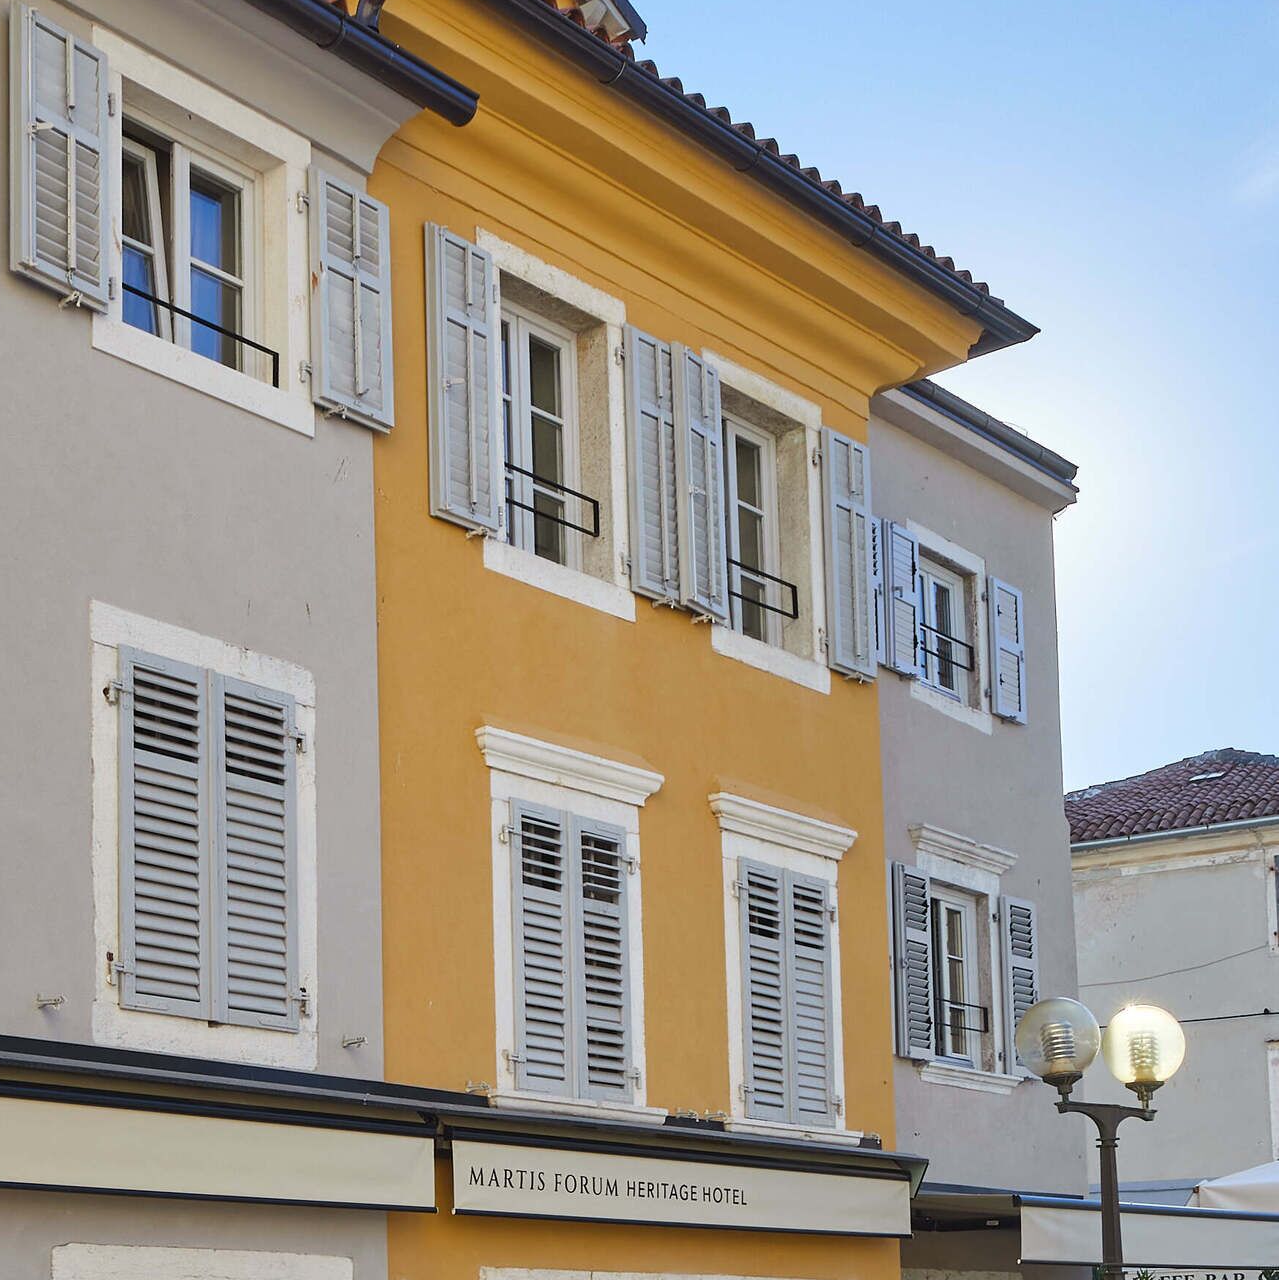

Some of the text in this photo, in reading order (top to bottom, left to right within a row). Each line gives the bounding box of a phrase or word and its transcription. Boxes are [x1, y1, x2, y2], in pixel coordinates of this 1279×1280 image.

[469, 1166, 747, 1205] MARTIS FORUM HERITAGE HOTEL
